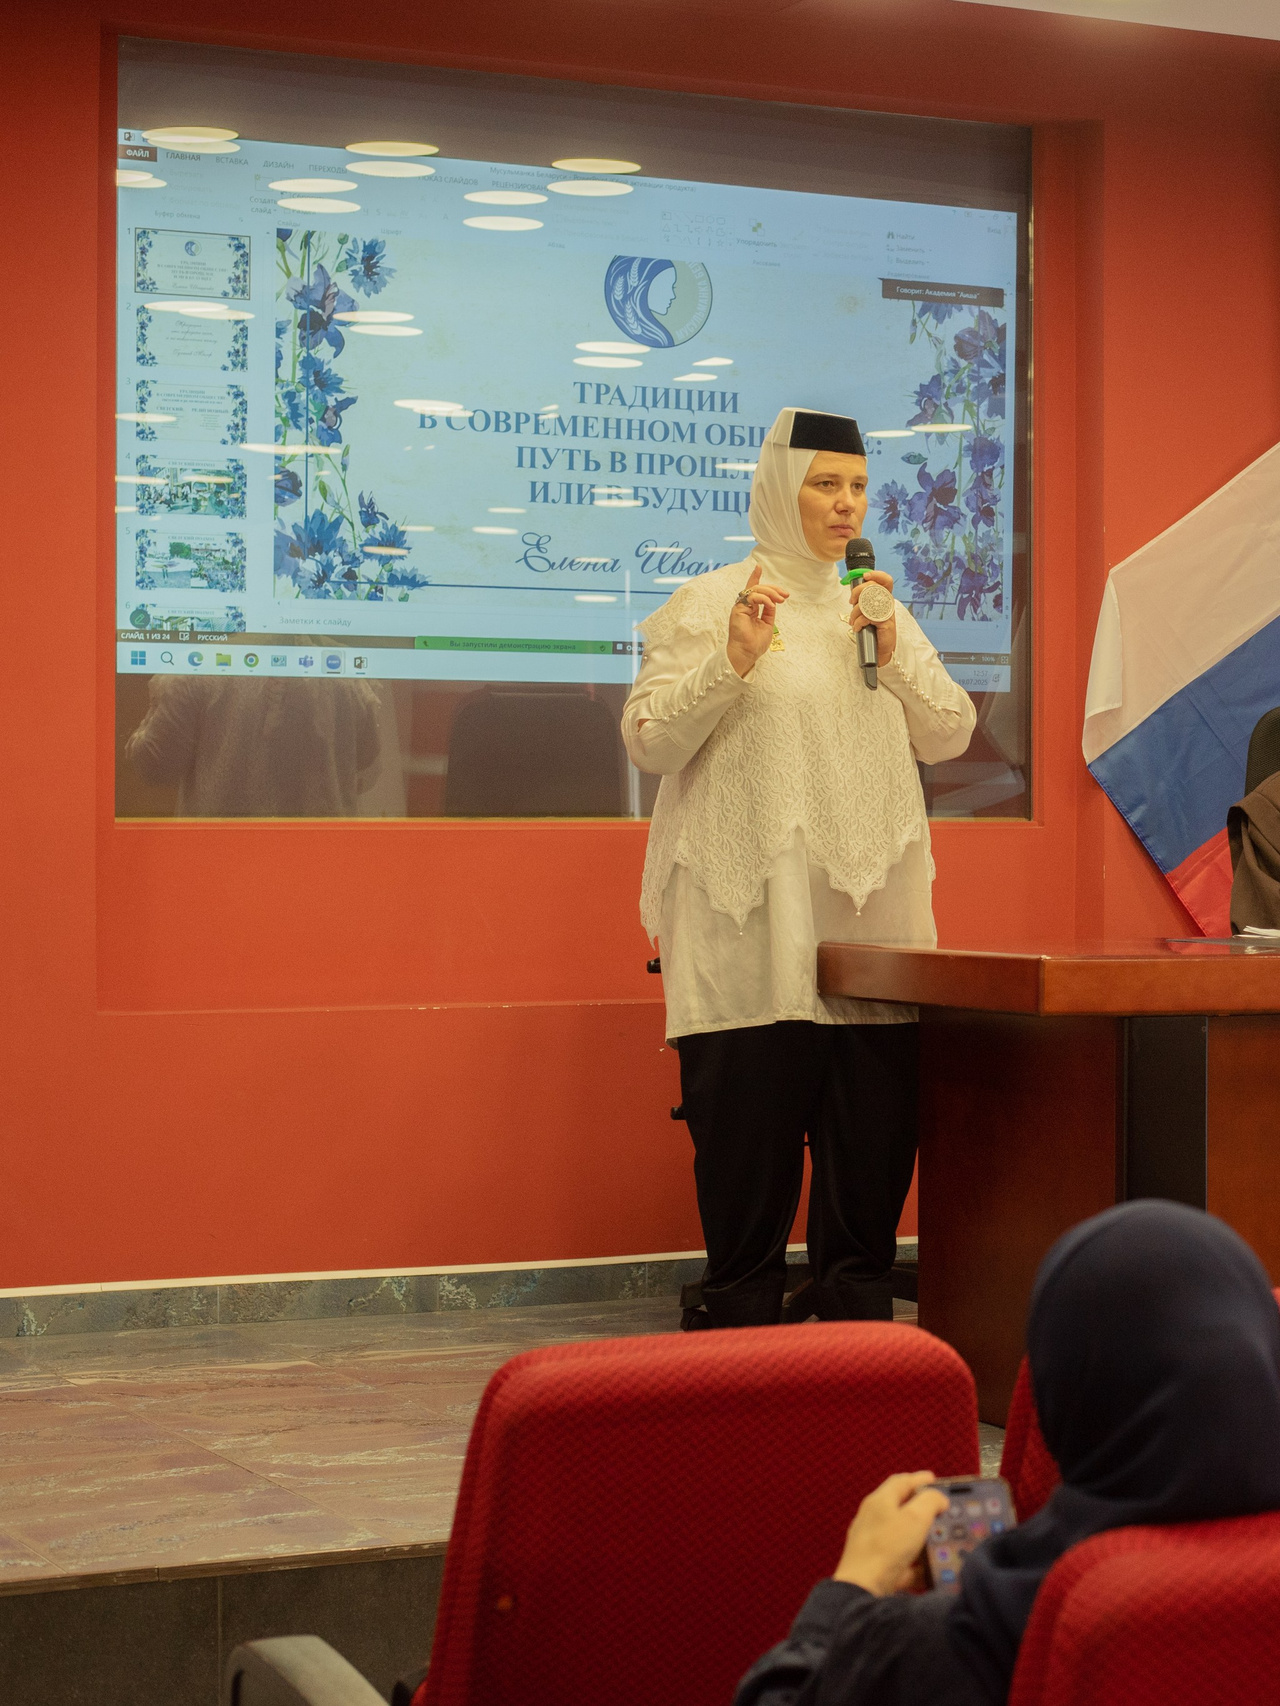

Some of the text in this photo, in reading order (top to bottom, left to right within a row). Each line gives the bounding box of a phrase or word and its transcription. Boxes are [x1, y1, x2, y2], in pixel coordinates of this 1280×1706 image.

[126, 148, 150, 158] ФАЙЛ
[166, 151, 201, 162] ГЛАВНАЯ
[215, 156, 249, 166] ВСТАВКА
[262, 160, 295, 170] ДИЗАЙН
[308, 164, 348, 174] ПЕРЕХОДЫ
[489, 166, 535, 178] Мусульманка
[444, 176, 479, 186] СЛАЙДОВ
[491, 180, 555, 193] РЕЦЕНЗИРОВАН
[572, 381, 741, 416] ТРАДИЦИИ
[417, 409, 438, 429] В
[445, 408, 698, 445] СОВРЕМЕННОМ
[515, 445, 760, 481] ПУТЬ В ПРОШЛ
[528, 480, 597, 506] ИЛИ
[632, 485, 751, 518] БУДУЩ
[515, 531, 622, 573] Елена
[279, 615, 314, 626] Заметки
[321, 618, 352, 628] слайду
[120, 631, 145, 641] СЛАЙД
[197, 633, 228, 642] РУССКИЙ
[449, 640, 461, 648] Вы
[461, 641, 498, 650] запустили
